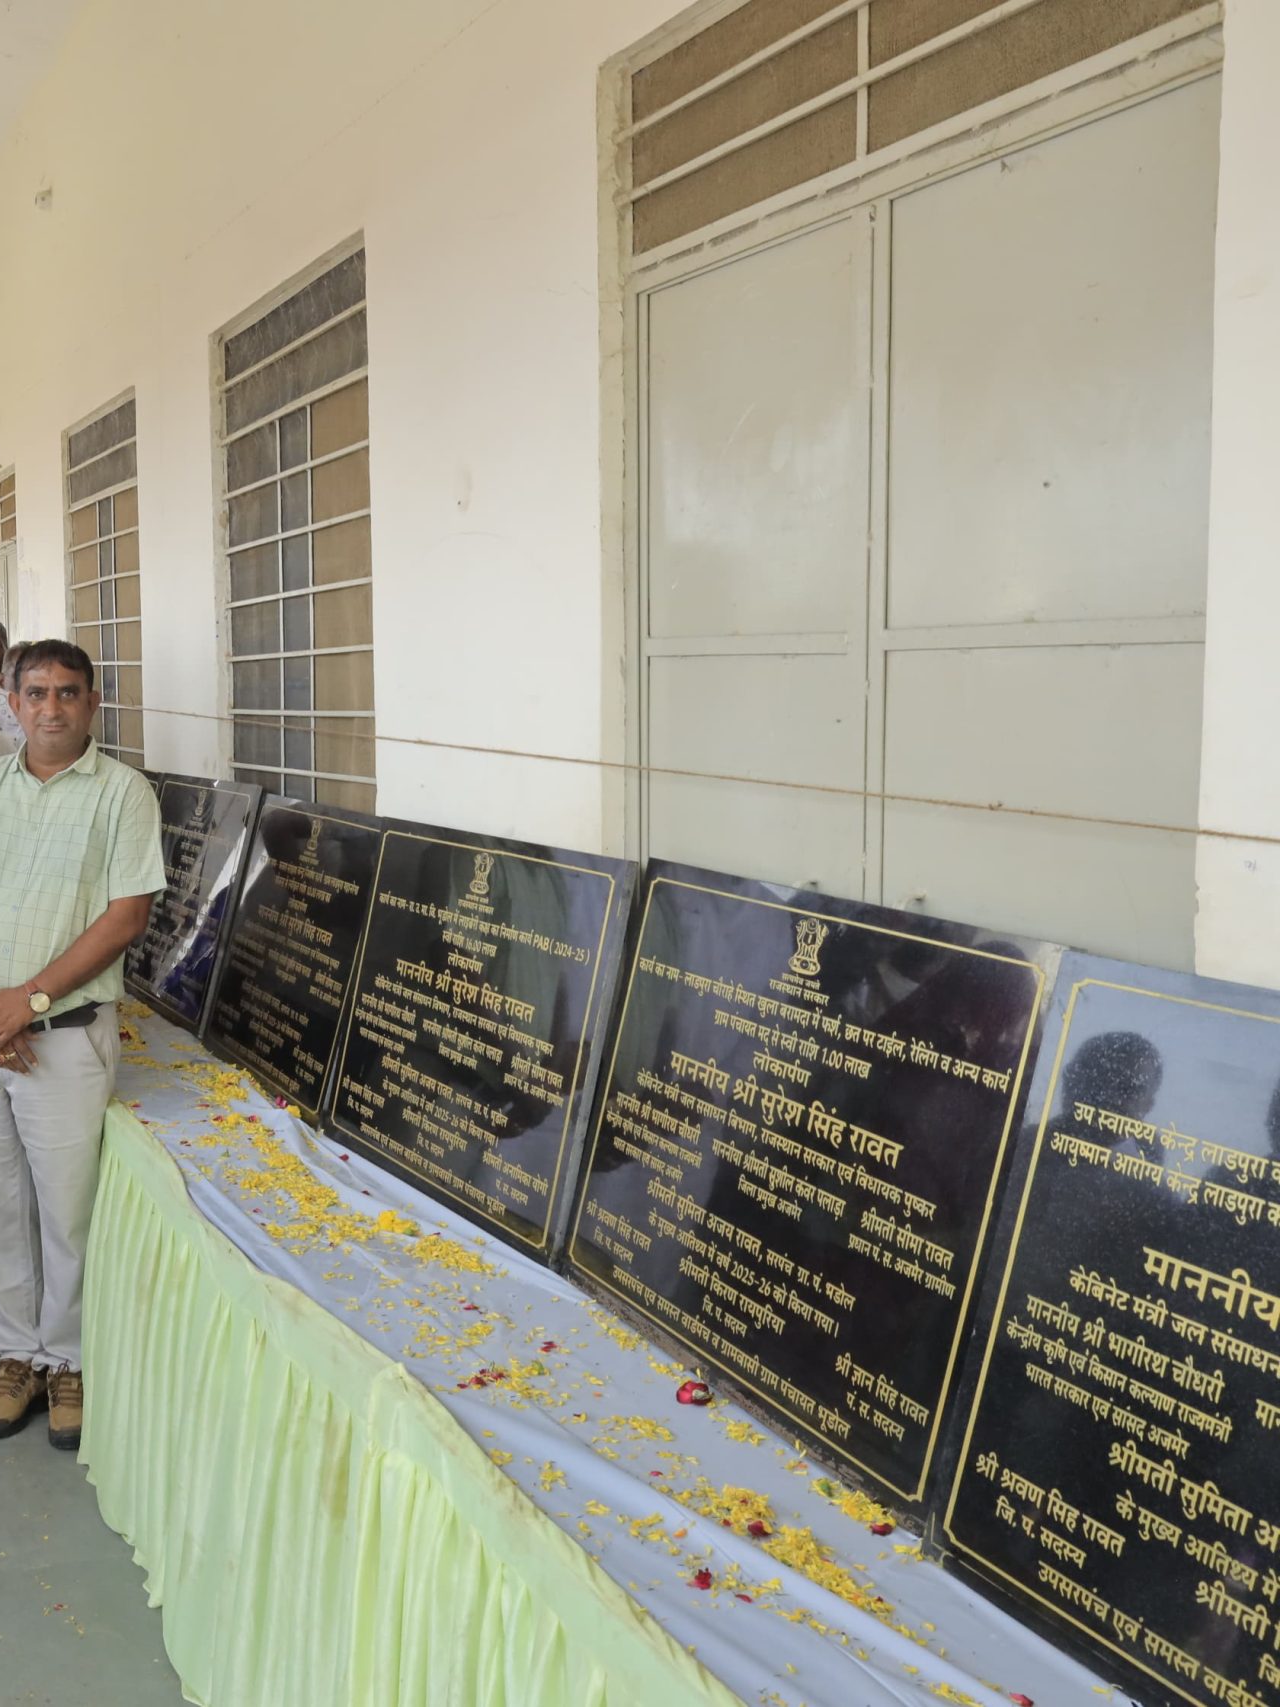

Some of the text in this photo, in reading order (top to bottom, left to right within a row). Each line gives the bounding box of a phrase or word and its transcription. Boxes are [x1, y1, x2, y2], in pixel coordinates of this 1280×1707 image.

[395, 957, 536, 1024] माननीय श्री सुरेश सिंह रावत
[447, 951, 484, 975] लोकार्पण
[714, 1009, 873, 1080] ग्राम पंचायत मद से स्वी राशि 1.00 लाख
[752, 1050, 812, 1088] लोकार्पण
[636, 1069, 665, 1094] केबिनेट
[663, 1083, 681, 1102] मंत्री
[680, 1090, 697, 1110] जल
[760, 1127, 803, 1159] राजस्थान
[803, 1146, 837, 1175] सरकार
[837, 1161, 856, 1186] एवं
[855, 1165, 904, 1205] विधायक
[903, 1191, 938, 1221] पुष्कर
[670, 1050, 905, 1169] माननीय श्री सुरेश सिंह रावत
[1073, 1101, 1097, 1126] उप
[1097, 1108, 1158, 1145] स्वास्थ्य
[1159, 1121, 1200, 1162] केन्द्र
[1200, 1140, 1271, 1184] लाडपुरा
[1050, 1131, 1113, 1169] आयुष्मान
[1112, 1151, 1165, 1187] आरोग्य
[1166, 1168, 1202, 1205] केन्द्र
[1203, 1181, 1267, 1226] लाडपुरा
[646, 1177, 678, 1208] श्रीमती
[676, 1194, 708, 1225] सुमिता
[706, 1212, 736, 1242] अजय
[735, 1227, 763, 1263] रावत,
[766, 1248, 795, 1276] सरपंच
[797, 1265, 811, 1287] ग्रा.
[812, 1272, 824, 1294] पं.
[648, 1207, 658, 1227] के
[657, 1216, 677, 1239] मुख्य
[676, 1228, 708, 1257] आतिथ्य
[707, 1241, 718, 1263] में
[716, 1251, 733, 1272] वर्ष
[730, 1260, 772, 1297] 2025-26
[772, 1282, 788, 1306] को
[787, 1289, 815, 1322] किया
[860, 1206, 955, 1271] श्रीमती सीमा रावत
[678, 1255, 786, 1336] श्रीमती किरण रायपुरिया
[1069, 1264, 1131, 1311] केबिनेट
[1132, 1294, 1169, 1329] मंत्री
[1170, 1312, 1210, 1346] जल
[1142, 1246, 1280, 1333] माननीय
[612, 1264, 646, 1296] उपसरपंच
[657, 1294, 682, 1322] समस्त
[680, 1310, 712, 1343] वार्डपंच
[711, 1331, 721, 1350] व
[720, 1338, 761, 1376] ग्रामवासी
[760, 1364, 780, 1390] ग्राम
[780, 1377, 817, 1415] पंचायत
[817, 1404, 852, 1440] भूडोल
[835, 1352, 930, 1427] श्री ज्ञान सिंह रावत
[1006, 1315, 1043, 1351] केन्द्रीय
[1042, 1337, 1069, 1365] कृषि
[1068, 1348, 1090, 1376] एवं
[1087, 1354, 1129, 1393] किसान
[1128, 1378, 1178, 1416] कल्याण
[1177, 1401, 1234, 1444] राज्यमंत्री
[1026, 1293, 1226, 1404] माननीय श्री भागीरथ चौधरी
[1025, 1362, 1191, 1460] भारत सरकार एवं सांसद अजमेर
[975, 1451, 1000, 1481] श्री
[1000, 1467, 1046, 1509] श्रवण
[1082, 1513, 1126, 1558] रावत
[995, 1495, 1087, 1569] जि. प. सदस्य
[1108, 1439, 1254, 1536] श्रीमती सुमिता
[1115, 1489, 1137, 1521] के
[1137, 1506, 1183, 1549] मुख्य
[1183, 1534, 1259, 1592] आतिथ्य
[1038, 1559, 1201, 1681] उपसरपंच एवं समस्त
[1195, 1580, 1272, 1641] श्रीमती
